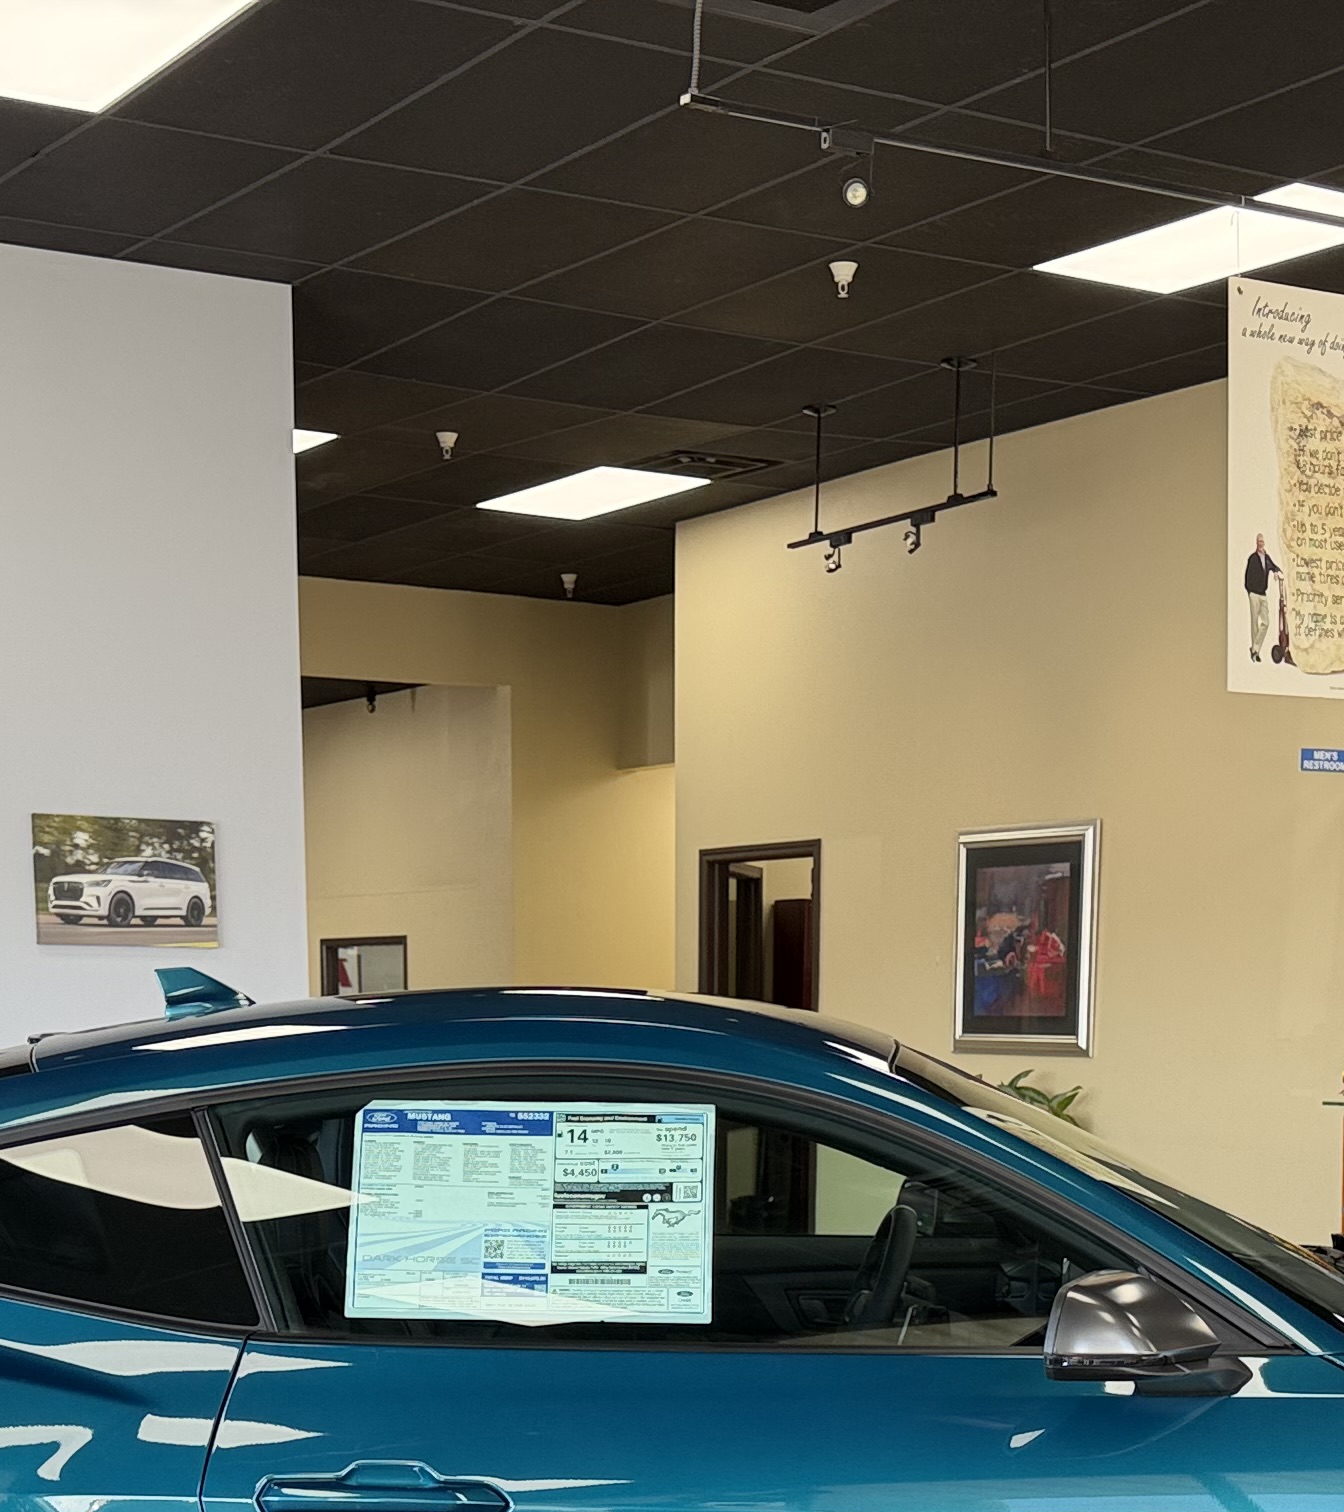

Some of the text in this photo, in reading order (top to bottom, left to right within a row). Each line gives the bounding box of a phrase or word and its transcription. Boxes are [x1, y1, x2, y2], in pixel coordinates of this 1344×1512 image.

[1252, 295, 1312, 333] Introducing
[1241, 327, 1248, 338] a
[1249, 322, 1276, 341] whole
[1277, 333, 1296, 344] new
[1297, 337, 1316, 355] way
[1317, 332, 1330, 356] of
[1307, 503, 1323, 518] you
[1296, 519, 1307, 535] Up
[1309, 521, 1319, 535] to
[1320, 522, 1327, 536] 5
[1296, 536, 1307, 548] on
[1308, 537, 1328, 550] most
[1296, 553, 1323, 570] Lowest
[1296, 588, 1329, 608] Priority
[1313, 750, 1339, 761] MEN'S
[406, 1112, 452, 1121] MUSTANG
[566, 1128, 589, 1144] 14
[656, 1133, 697, 1143] $13,750
[562, 1168, 598, 1178] $4,450
[362, 1254, 481, 1266] DARK HORSE SC
